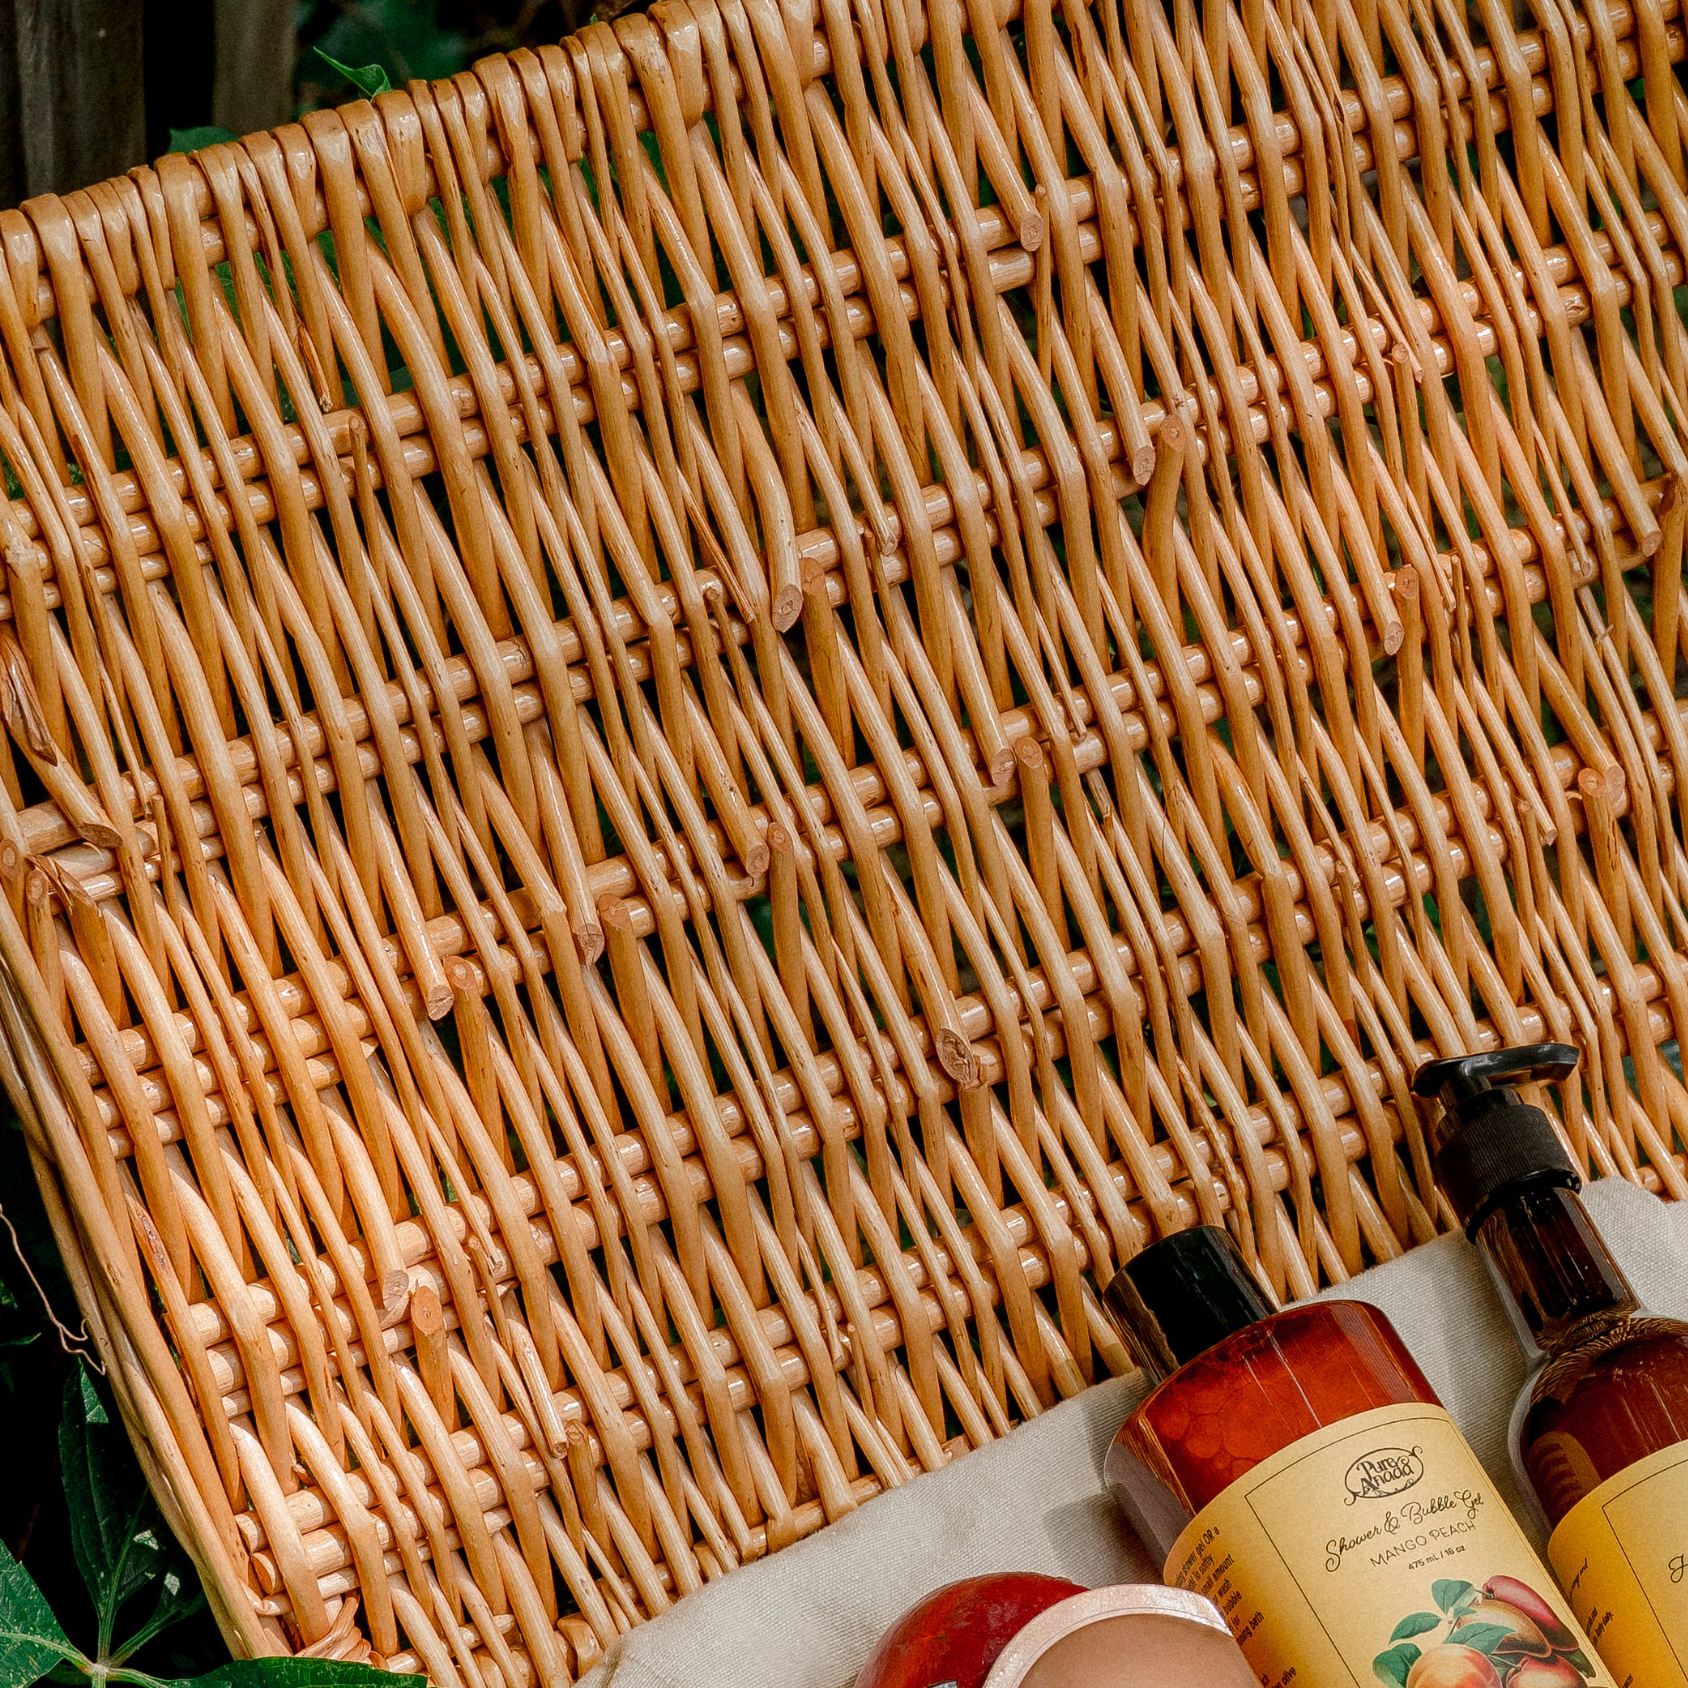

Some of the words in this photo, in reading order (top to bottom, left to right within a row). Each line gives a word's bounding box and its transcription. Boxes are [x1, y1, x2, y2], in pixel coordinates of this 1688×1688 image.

[1356, 1457, 1399, 1479] Pure
[1360, 1457, 1414, 1496] Anada
[1202, 1529, 1216, 1545] OR
[1213, 1526, 1221, 1536] a
[1325, 1525, 1382, 1572] Shower
[1384, 1511, 1400, 1534] &
[1401, 1495, 1457, 1524] Bubble
[1454, 1490, 1483, 1519] Gel
[1369, 1535, 1427, 1567] MANGO
[1429, 1521, 1476, 1541] PEACH
[1212, 1553, 1235, 1581] amount
[1409, 1559, 1425, 1570] 475
[1427, 1552, 1439, 1564] mL
[1445, 1547, 1455, 1556] 16
[1455, 1545, 1466, 1553] oz
